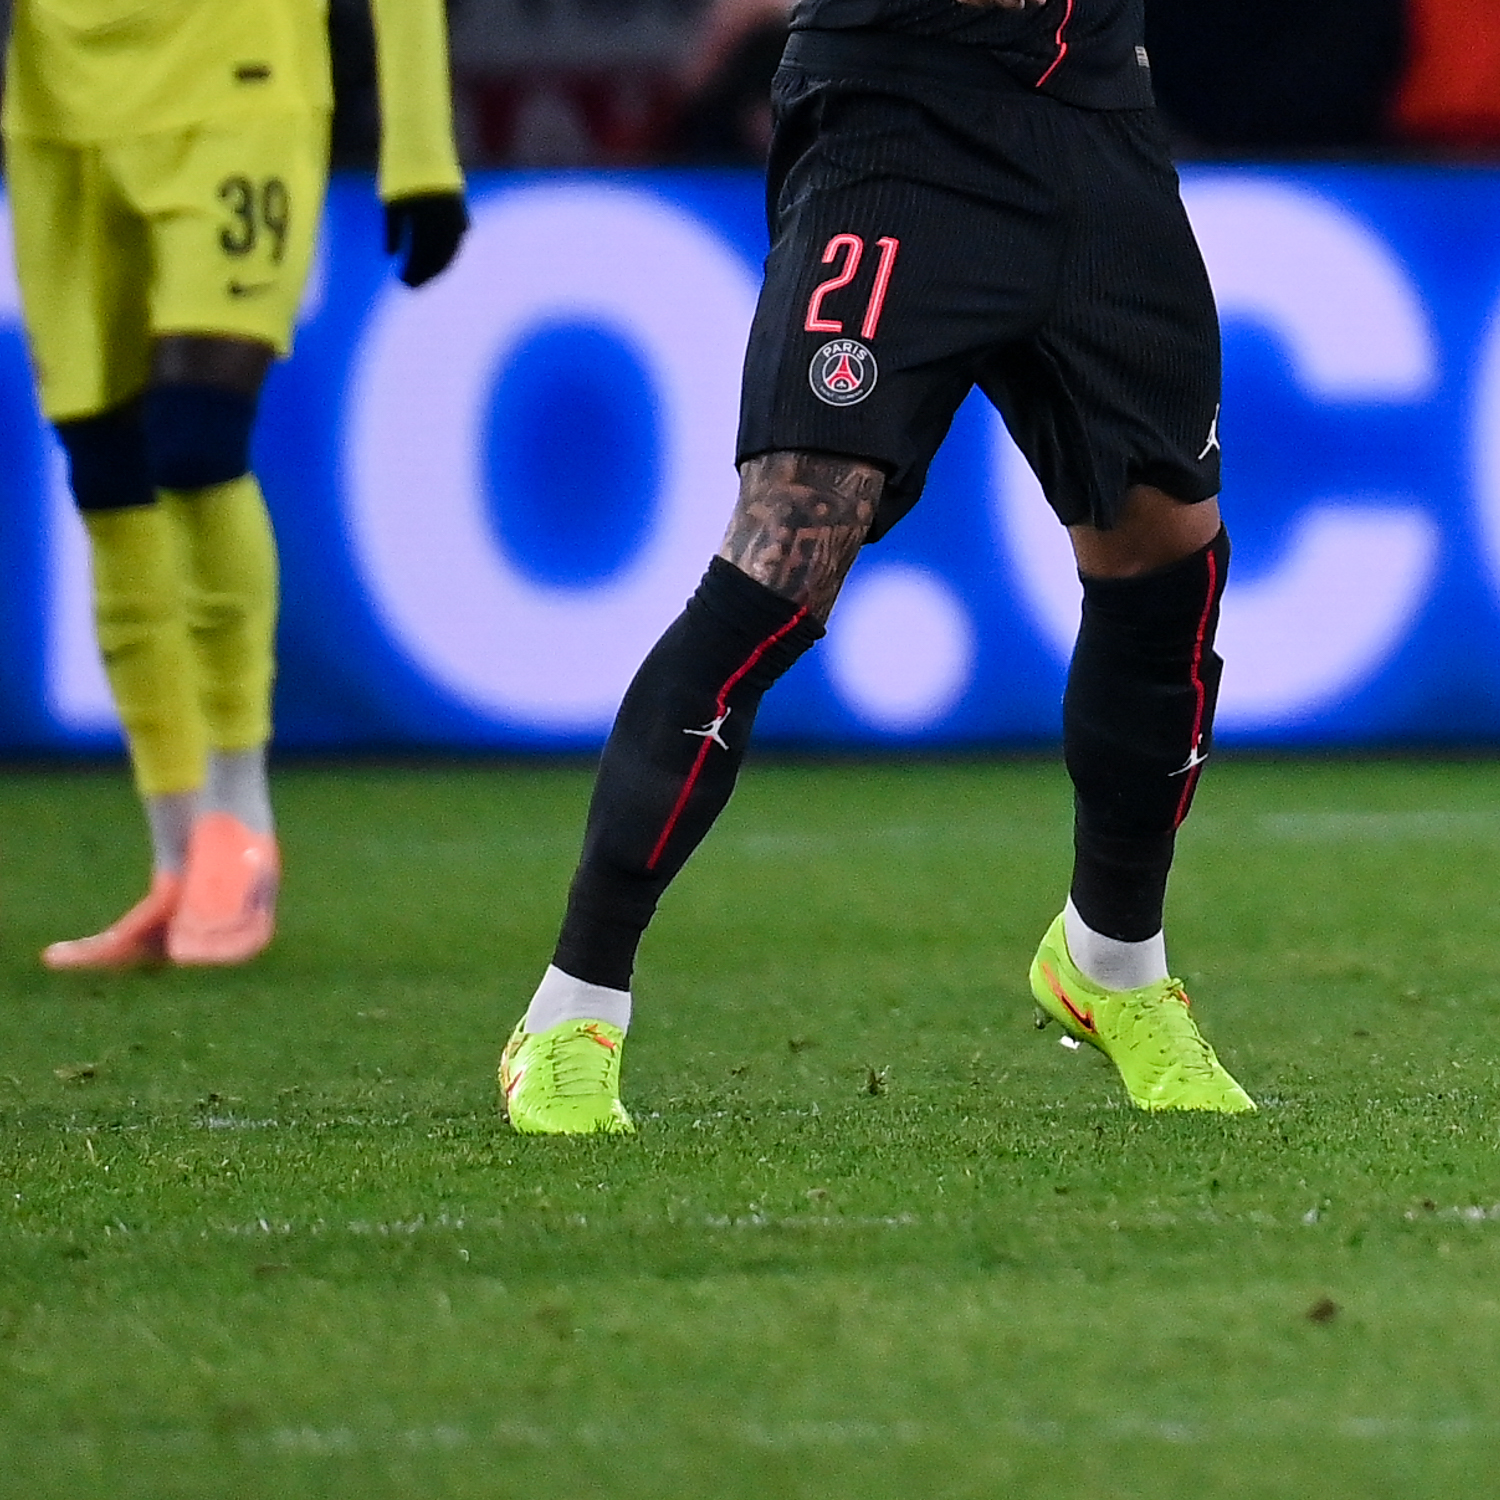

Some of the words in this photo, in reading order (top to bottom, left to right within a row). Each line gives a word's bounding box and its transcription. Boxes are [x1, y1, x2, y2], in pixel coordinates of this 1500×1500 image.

[217, 174, 291, 264] 39
[804, 233, 900, 340] 21
[822, 342, 868, 361] PARIS
